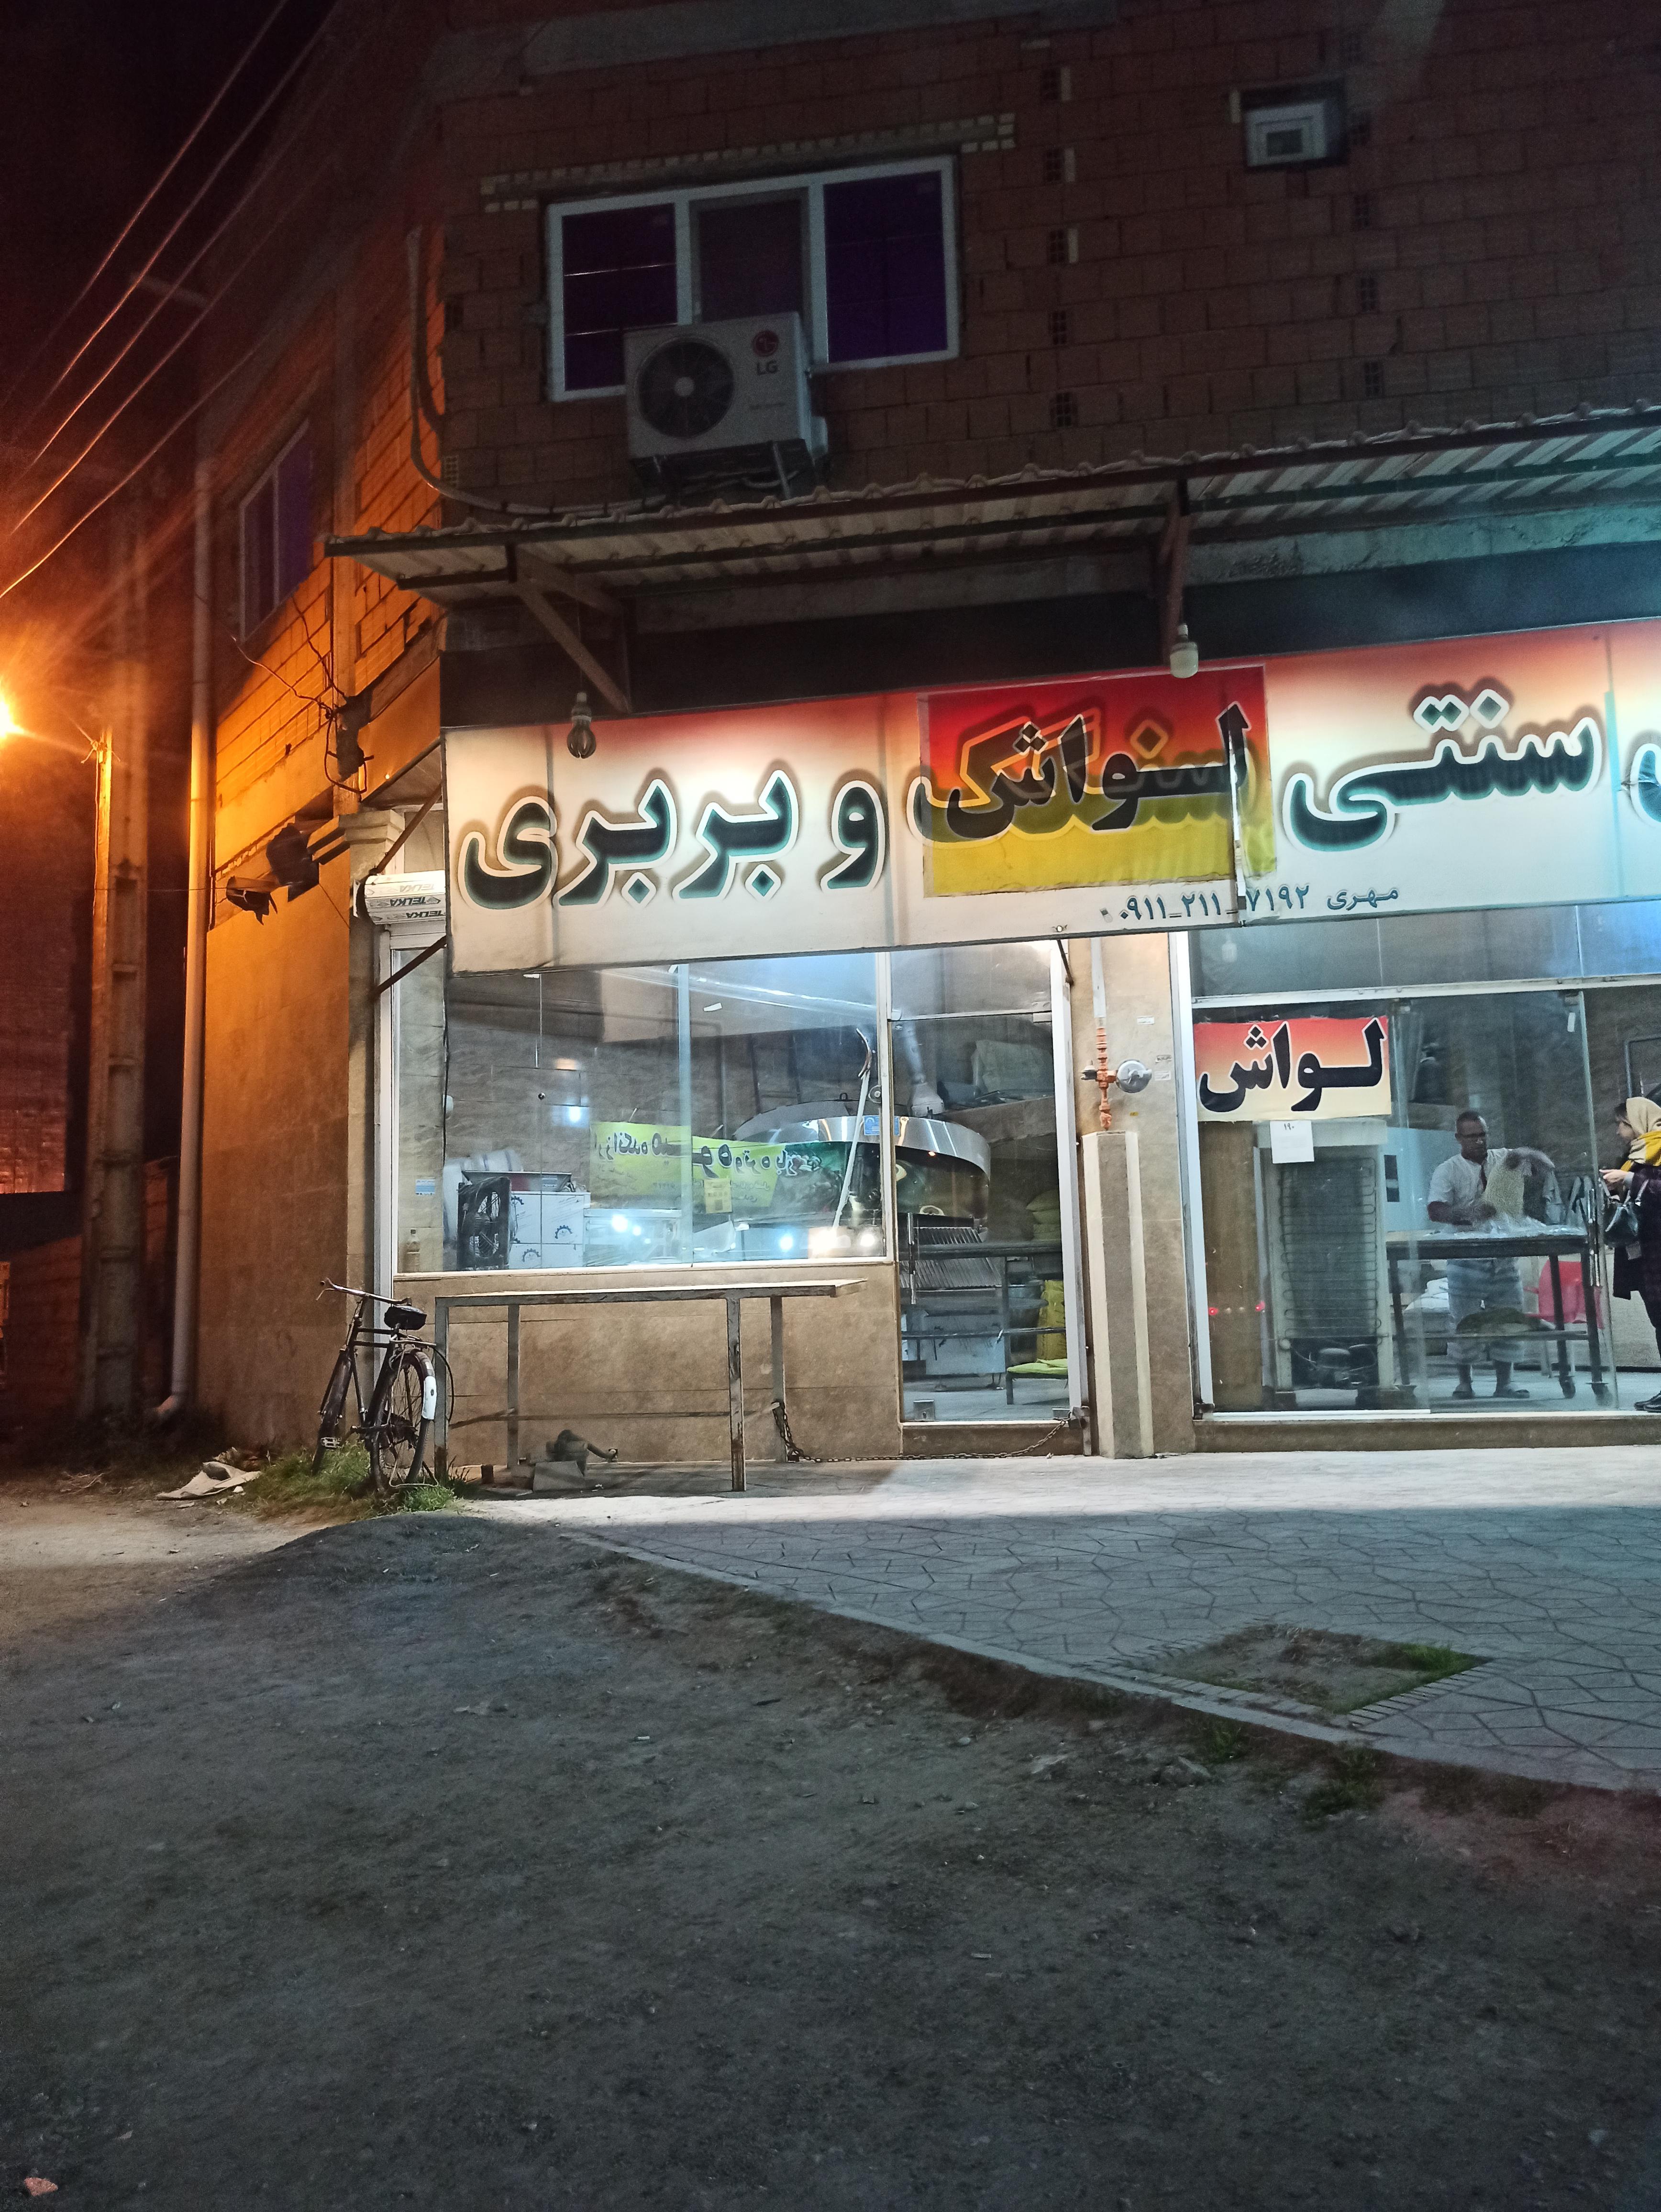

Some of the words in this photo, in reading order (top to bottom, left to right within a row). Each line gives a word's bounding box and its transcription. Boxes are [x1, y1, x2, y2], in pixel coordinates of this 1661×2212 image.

[757, 360, 778, 376] LG
[945, 701, 1251, 840] لواش
[1286, 692, 1599, 854] سنتی
[461, 772, 796, 911] بربری
[821, 783, 883, 891] و
[1327, 889, 1399, 911] مهری
[1198, 1017, 1386, 1114] لواش
